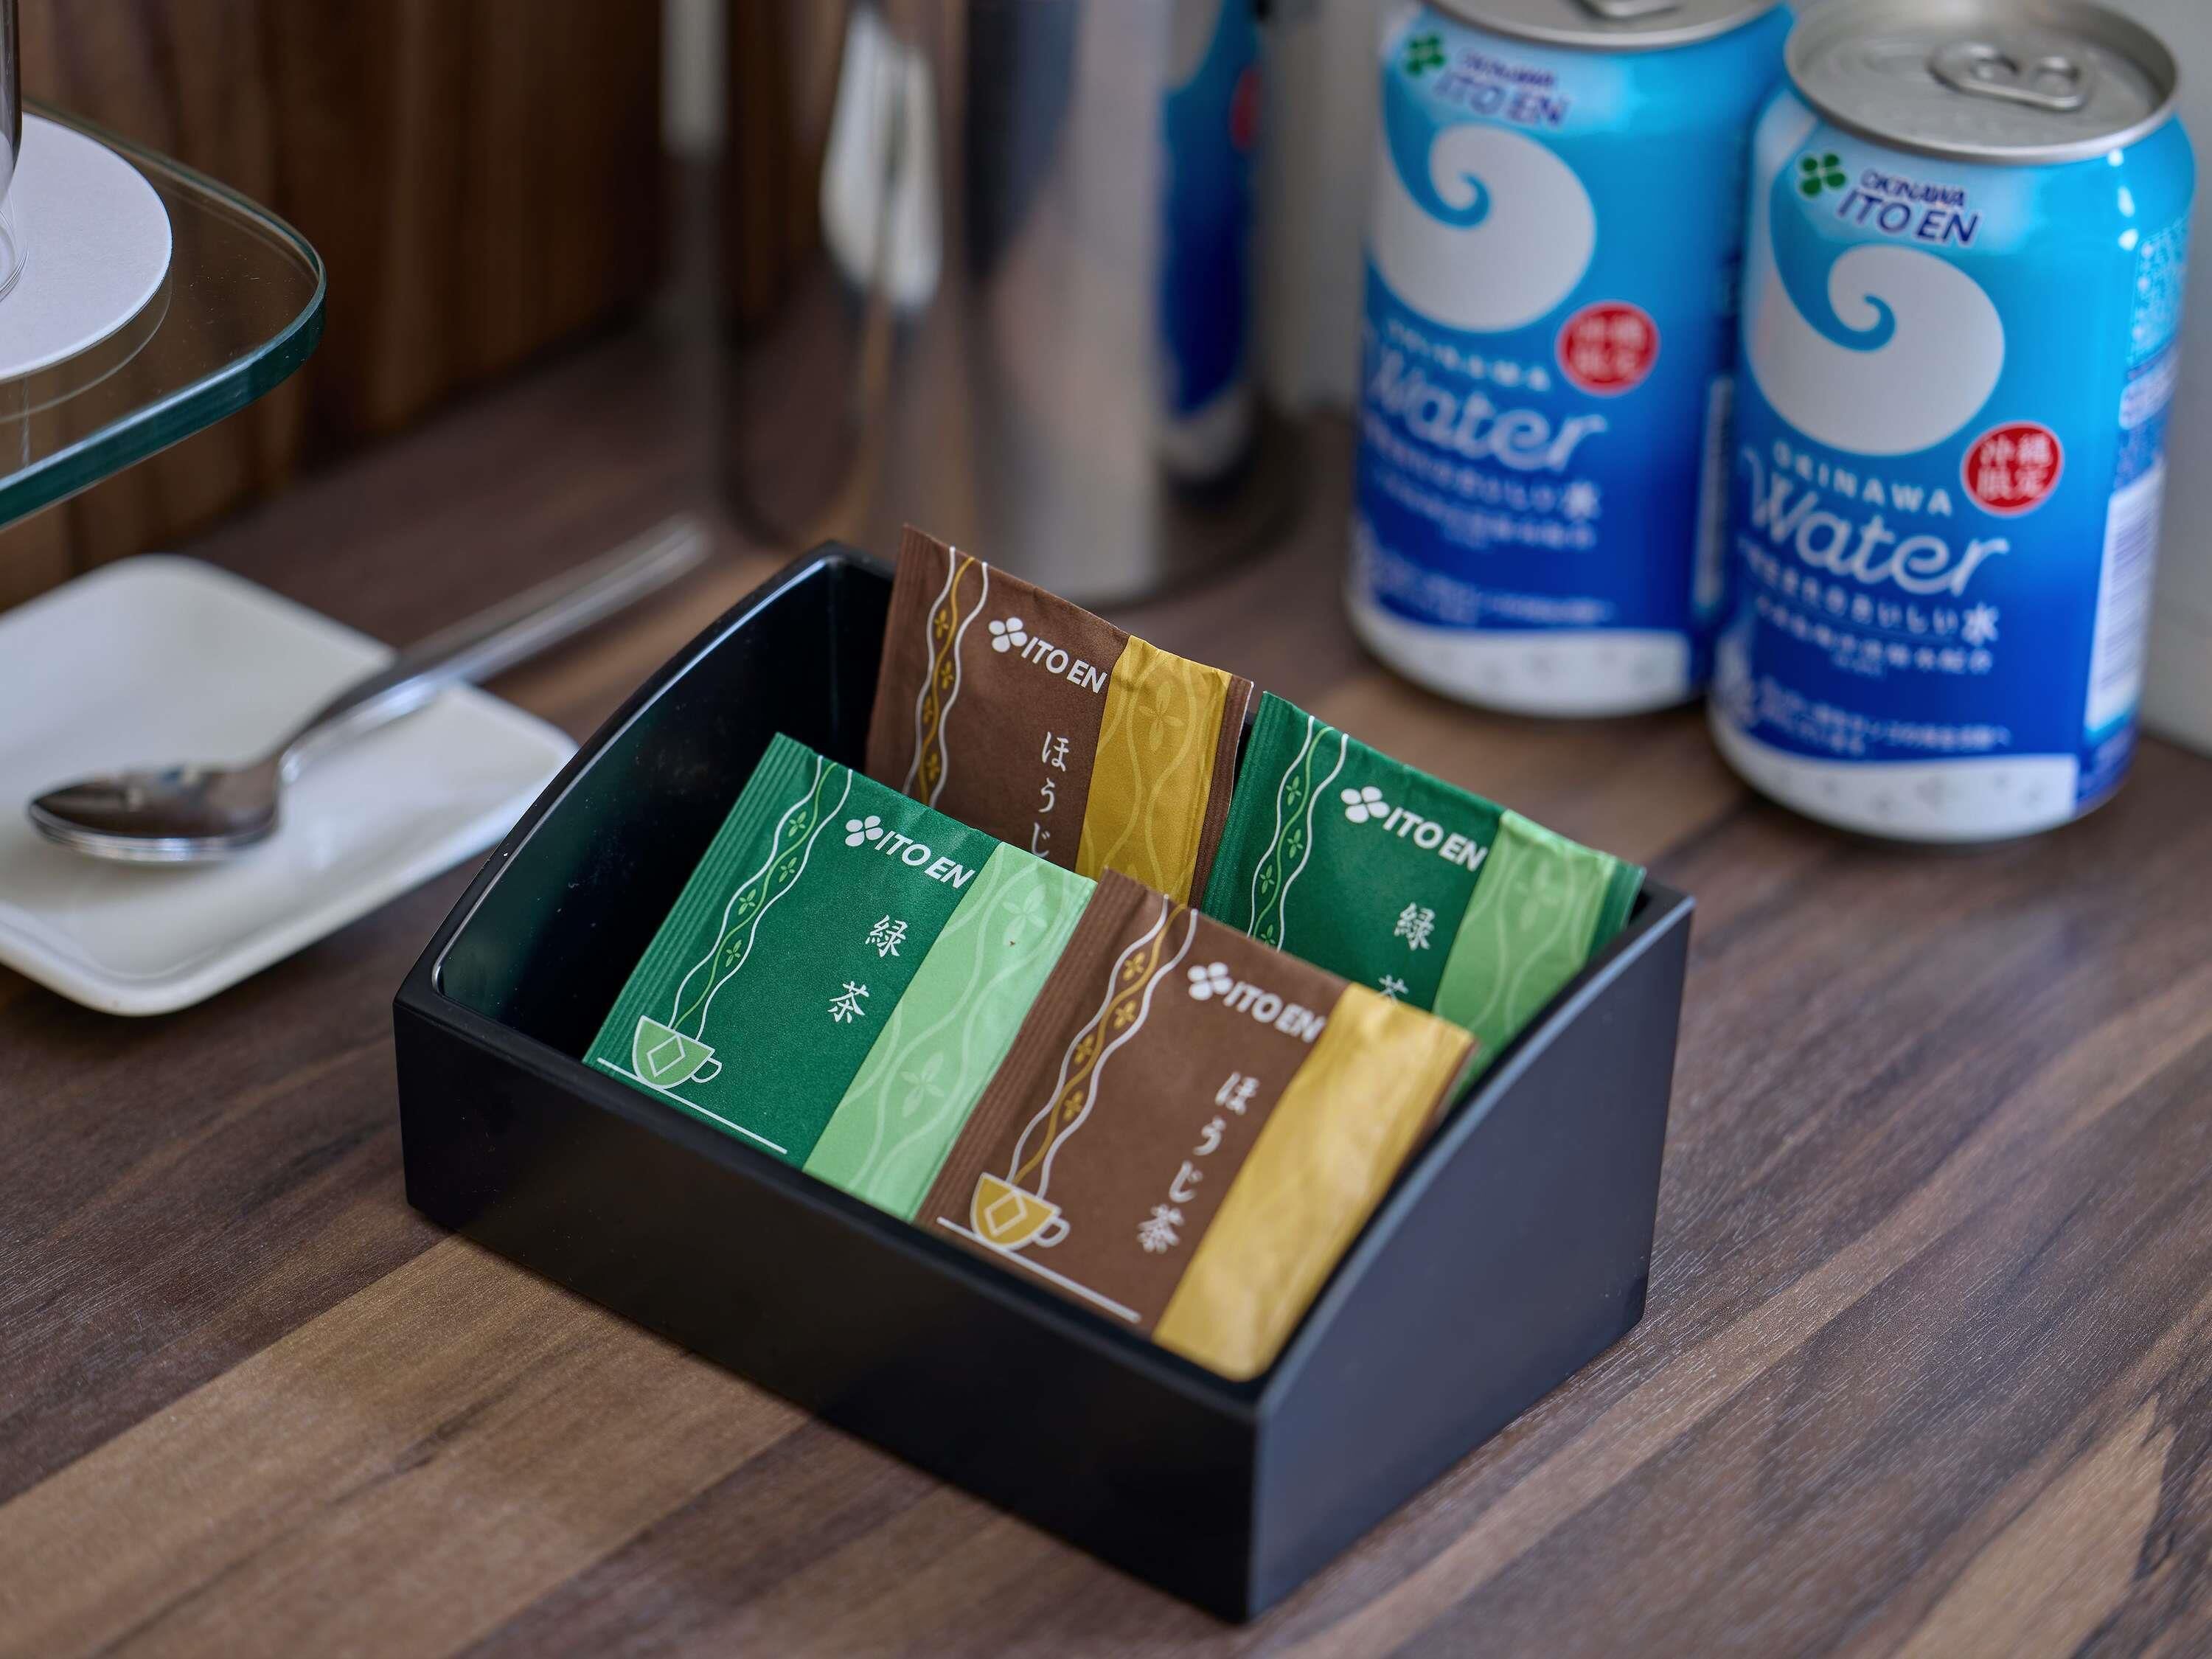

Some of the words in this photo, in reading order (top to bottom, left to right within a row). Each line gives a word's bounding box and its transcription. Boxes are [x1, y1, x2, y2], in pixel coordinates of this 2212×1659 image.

[1838, 189, 1912, 233] ITO
[1917, 209, 1978, 243] EN
[1773, 441, 1952, 516] OKINAWA
[1743, 447, 2009, 597] Water
[1020, 636, 1069, 675] ITO
[1067, 660, 1107, 694] EN
[874, 831, 932, 866] ITO
[925, 858, 975, 889] EN
[1382, 807, 1442, 849] ITO
[1438, 833, 1488, 872] EN
[827, 914, 909, 1023] 緑茶
[1222, 983, 1281, 1023] ITO
[1273, 1004, 1326, 1043] EN
[1137, 1071, 1259, 1253] ほうじ茶
